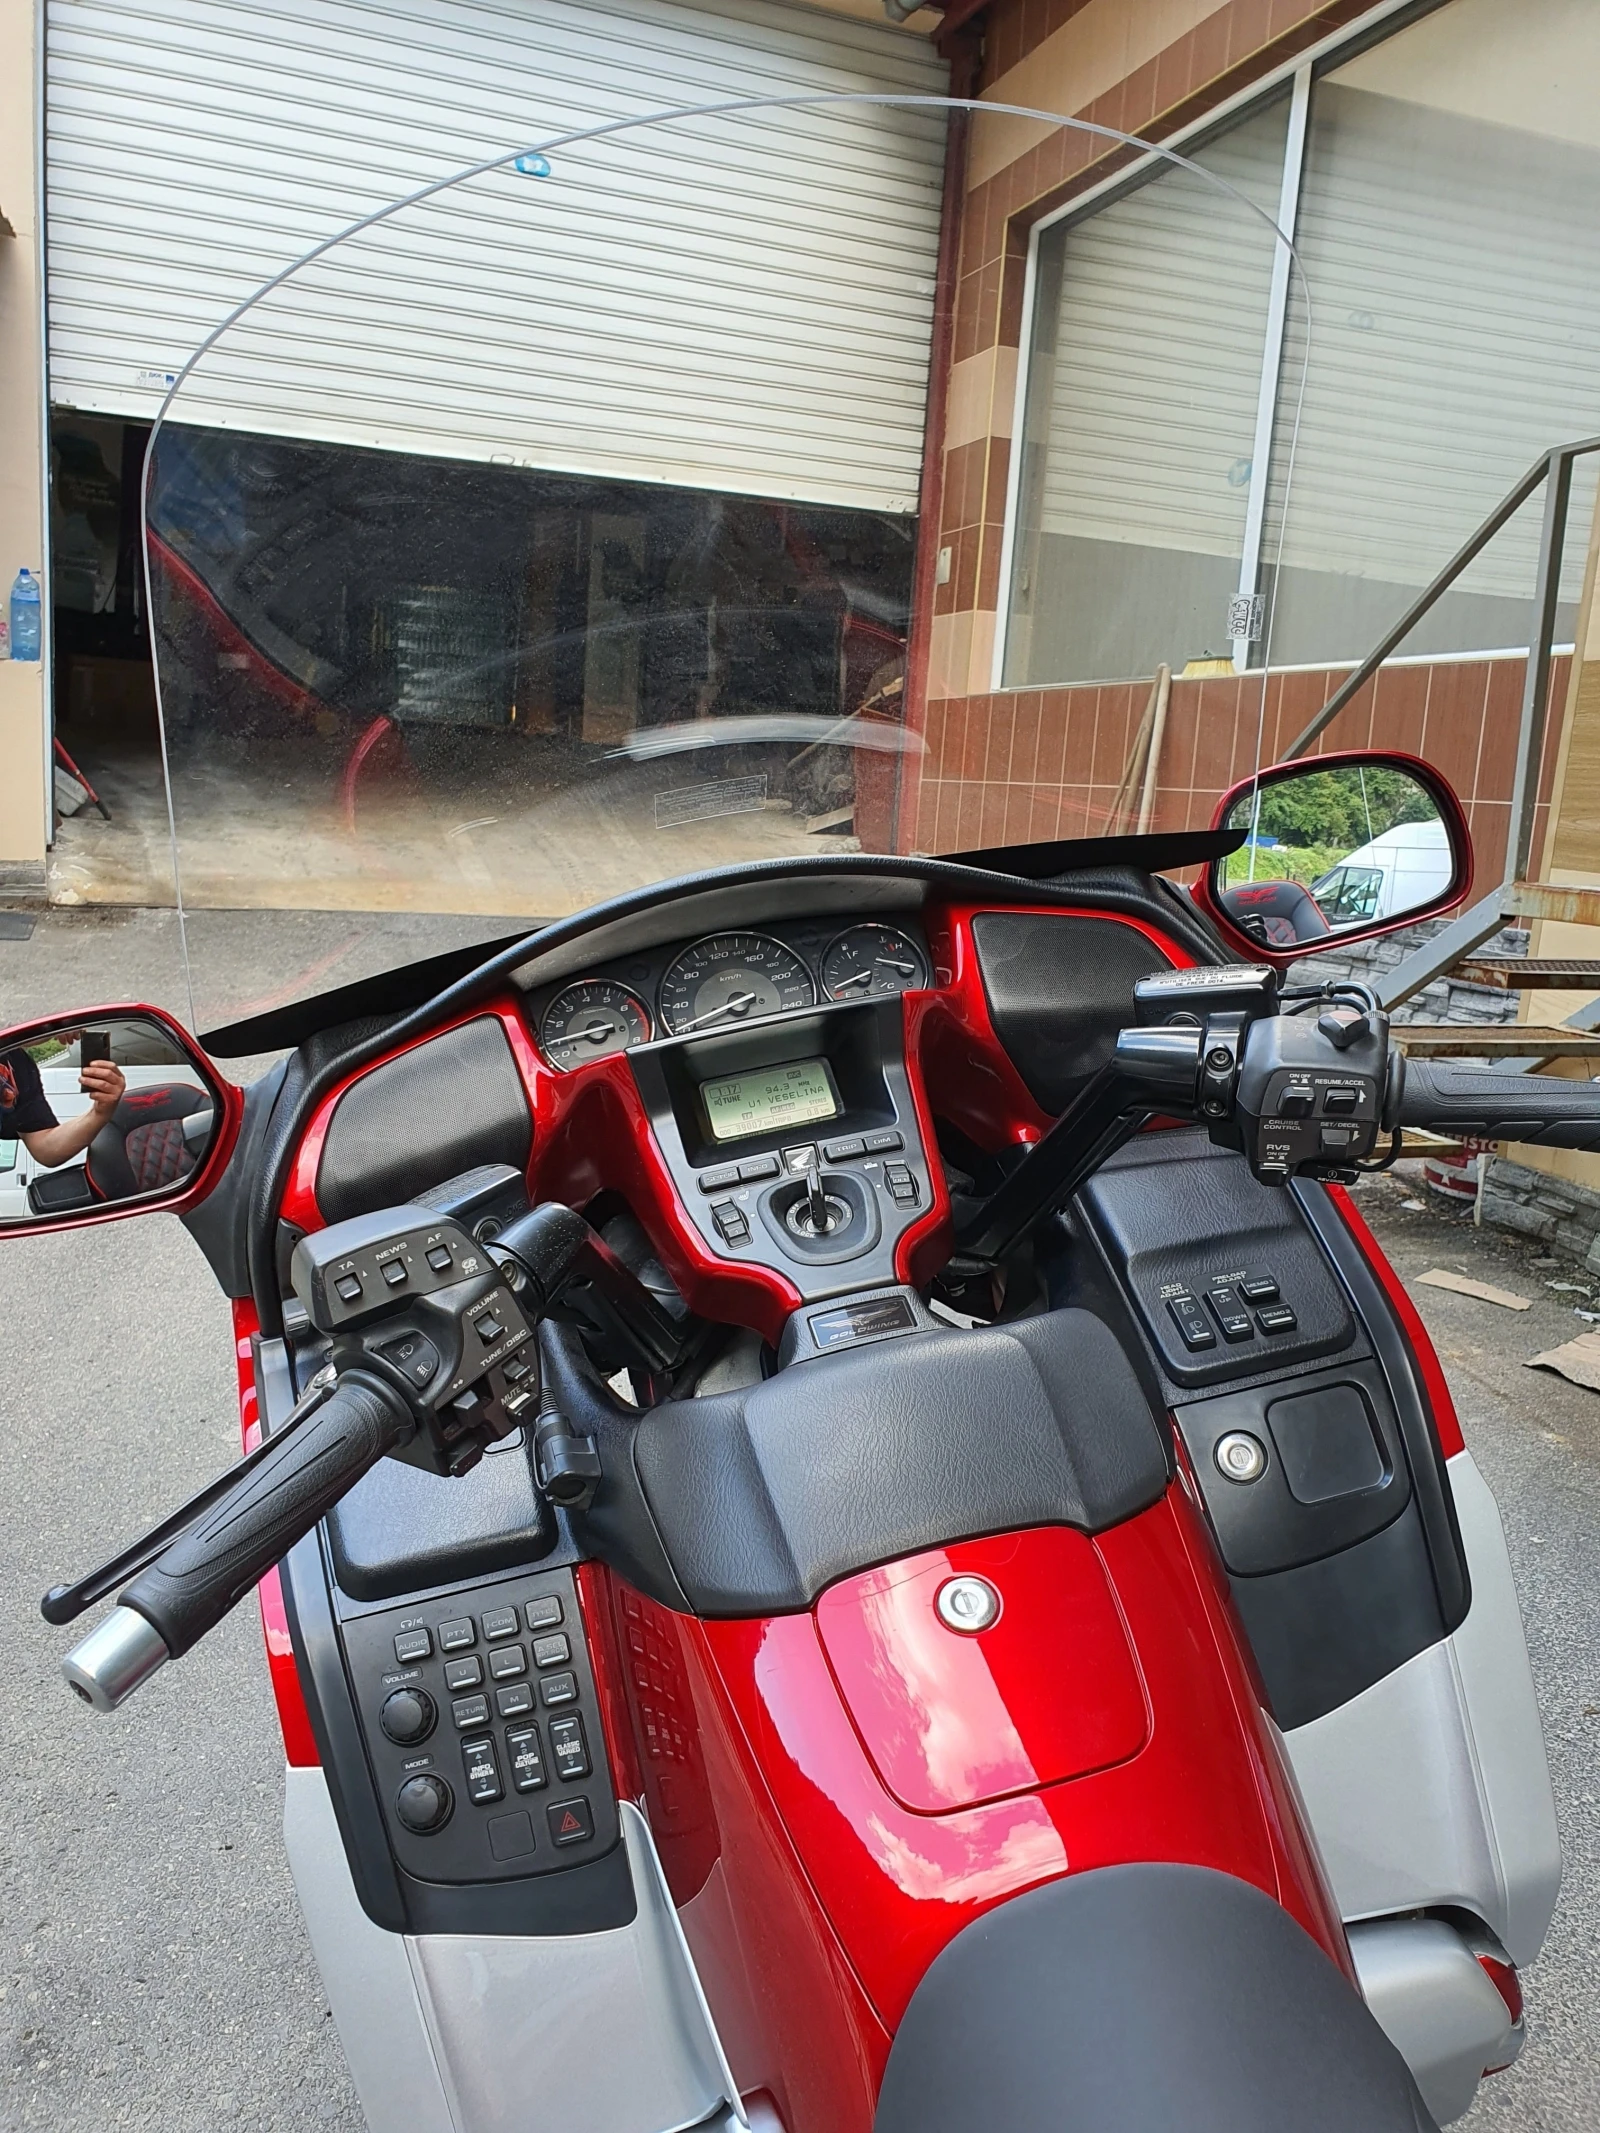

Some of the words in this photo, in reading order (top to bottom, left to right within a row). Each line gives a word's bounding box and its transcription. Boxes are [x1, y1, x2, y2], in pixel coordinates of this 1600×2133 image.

[895, 942, 902, 950] H
[708, 951, 729, 960] 120
[744, 953, 764, 962] 160
[683, 971, 700, 980] 80
[719, 973, 742, 982] km/h
[770, 972, 792, 982] 200
[672, 1001, 689, 1009] 40
[781, 1000, 802, 1010] 240
[555, 1020, 564, 1028] 2
[1314, 1078, 1366, 1086] RESUME/ACCEL
[765, 1083, 790, 1094] 94.3
[724, 1095, 741, 1104] TUNE
[748, 1099, 761, 1108] U1
[768, 1085, 824, 1104] VESELINA
[807, 1108, 819, 1117] 0.8
[736, 1119, 762, 1132] 39007
[873, 1136, 891, 1145] DIM
[835, 1143, 857, 1152] TRIP
[747, 1163, 768, 1172] INFO
[706, 1171, 737, 1182] SETUP
[790, 1203, 799, 1214] OFF
[427, 1232, 442, 1244] AF
[797, 1230, 815, 1238] LOCK
[375, 1242, 408, 1260] NEWS
[338, 1260, 355, 1270] TA
[1212, 1270, 1247, 1281] PRELOAD
[1216, 1274, 1246, 1284] ADJUST
[1160, 1282, 1182, 1290] HEAD
[1246, 1280, 1268, 1288] MEMO
[1160, 1289, 1189, 1299] ADJUST
[1161, 1286, 1183, 1294] LIGHT
[466, 1290, 500, 1316] VOLUME
[1223, 1314, 1247, 1322] DOWN
[1262, 1311, 1284, 1319] MEMO
[480, 1329, 527, 1367] TUNE/DISC
[500, 1385, 522, 1406] MUTE
[446, 1628, 466, 1639] PTY
[398, 1638, 427, 1650] AUDIO
[385, 1670, 419, 1684] VOLUME
[548, 1682, 569, 1693] AUX
[455, 1705, 485, 1717] RETURN
[556, 1740, 580, 1750] CLASSIC
[558, 1746, 580, 1756] VARIED
[515, 1756, 539, 1768] CULTURE
[517, 1752, 535, 1762] POP
[405, 1758, 429, 1770] MODE
[471, 1763, 490, 1773] INFO
[470, 1770, 489, 1780] OTHER
